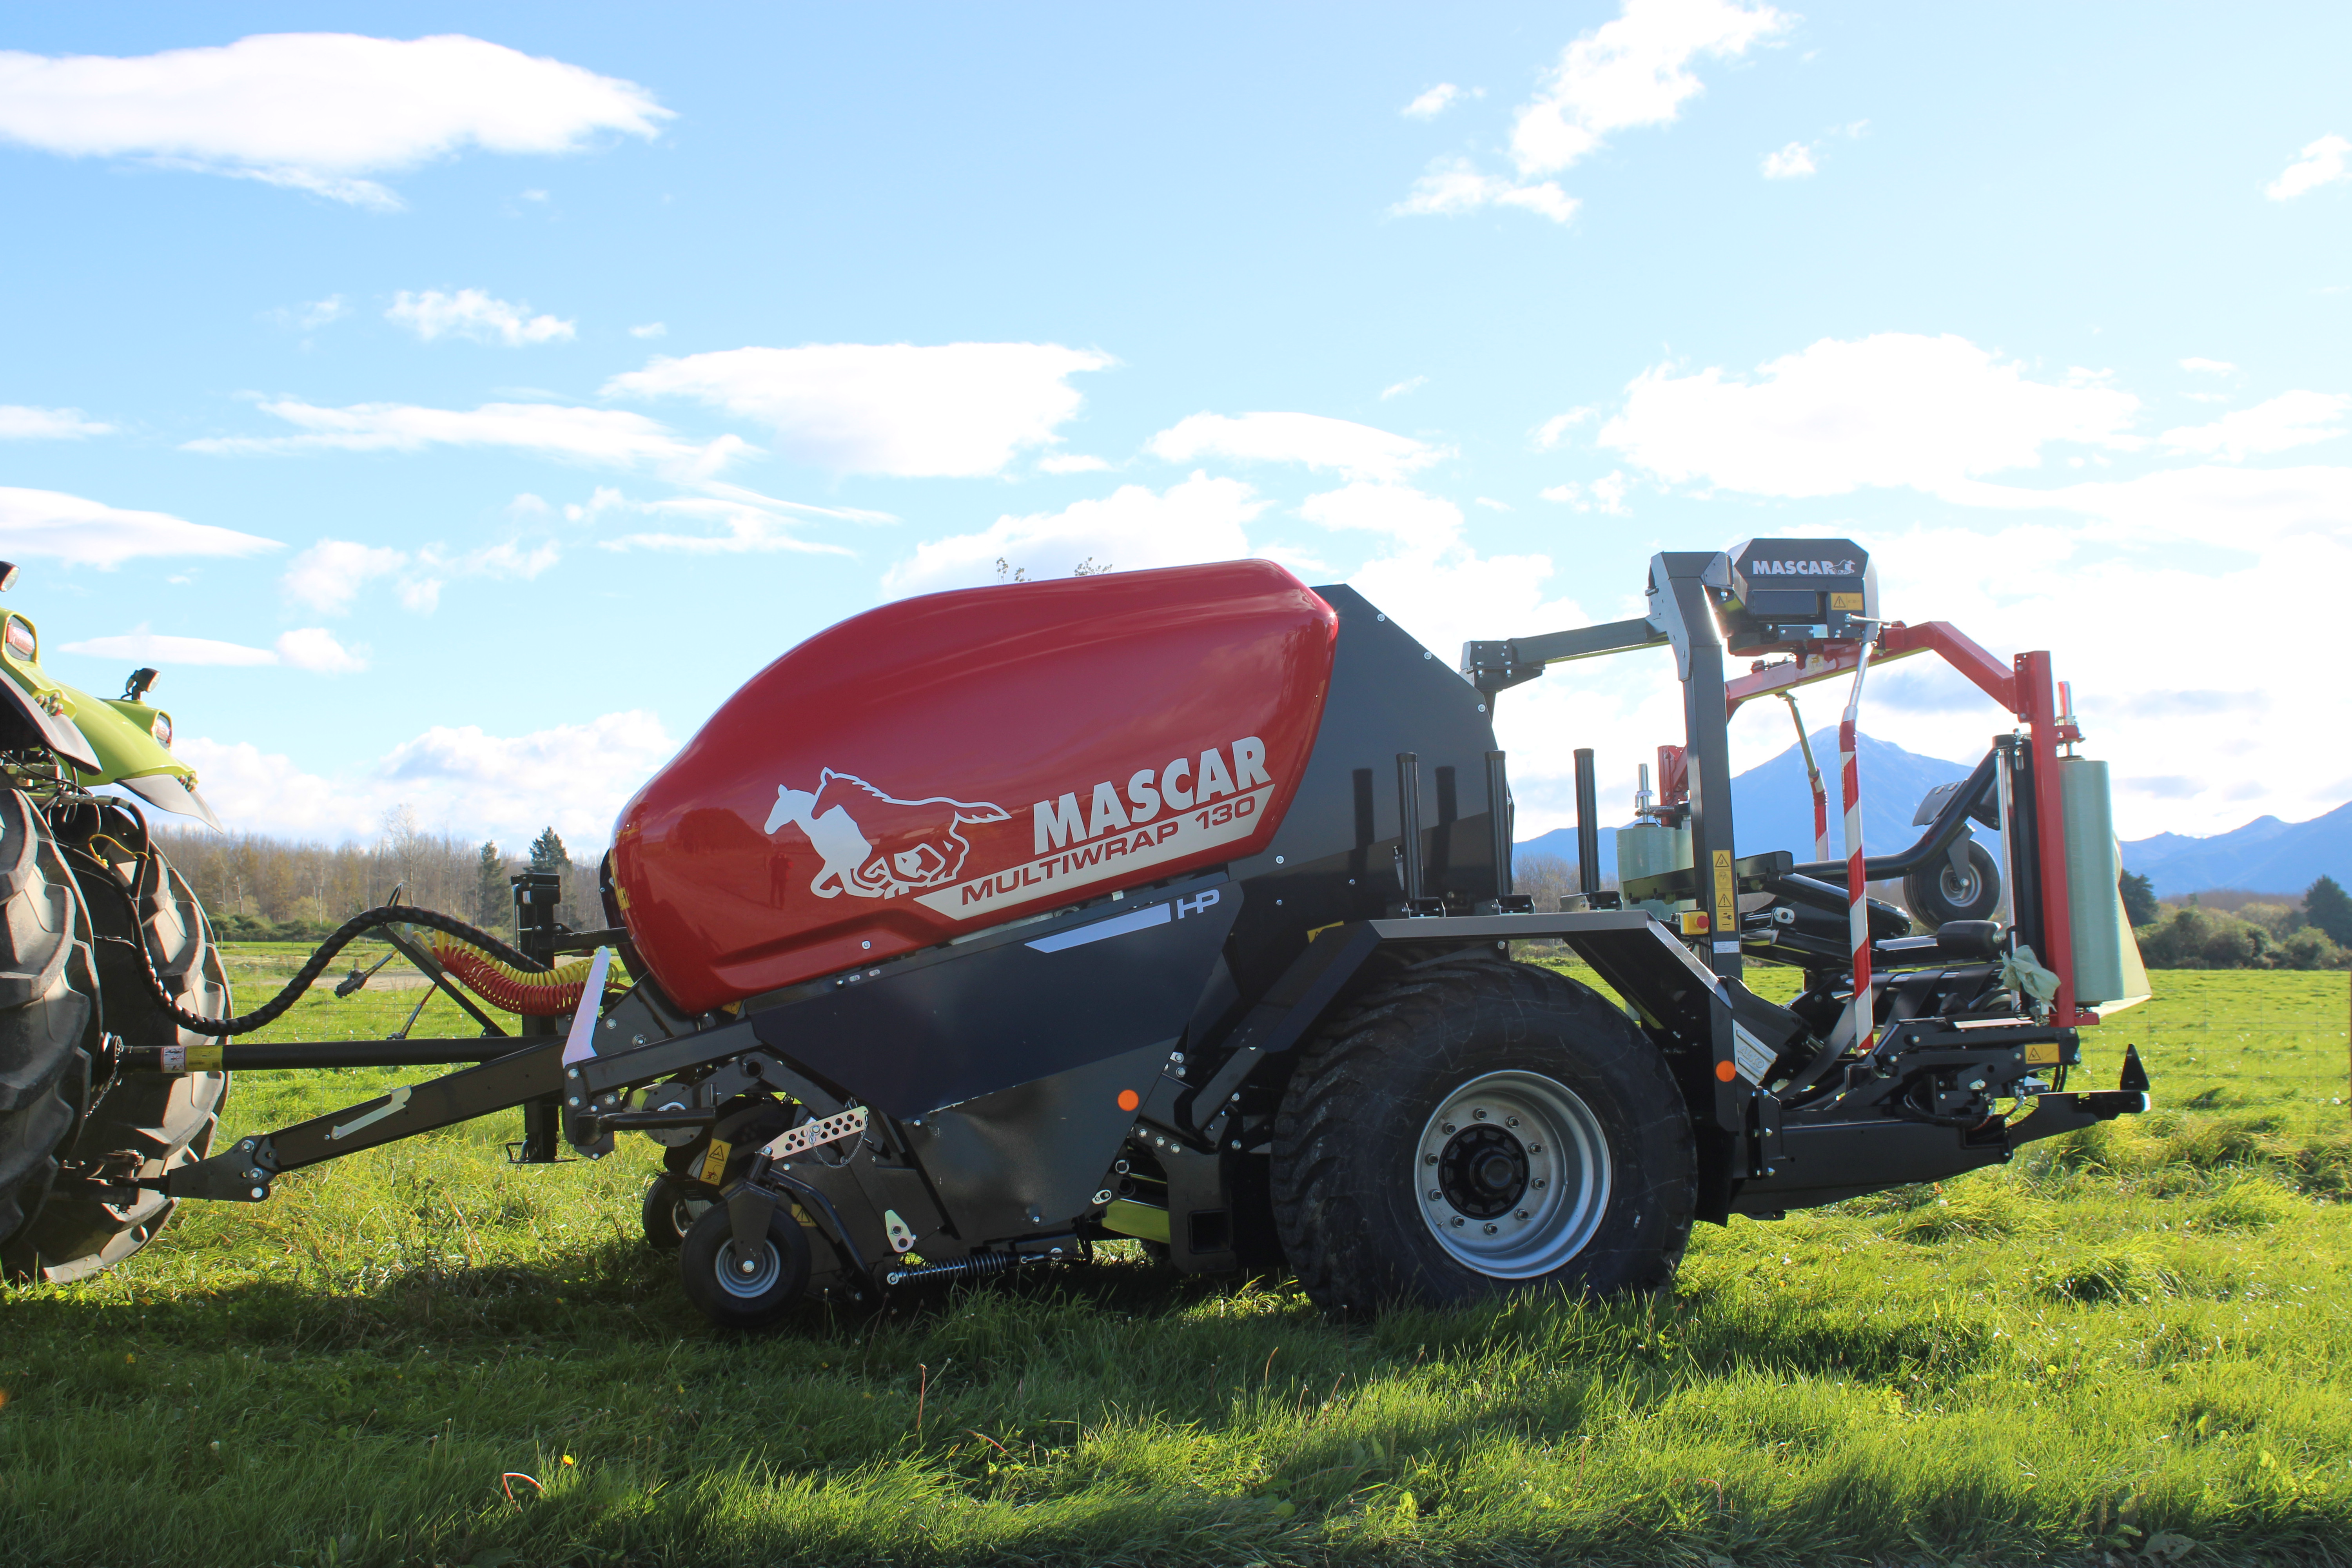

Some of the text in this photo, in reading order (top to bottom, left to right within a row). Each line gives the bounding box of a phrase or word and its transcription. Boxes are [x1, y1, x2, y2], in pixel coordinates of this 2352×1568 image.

[1753, 561, 1836, 575] MASCAR
[1033, 736, 1271, 856] MASCAR
[962, 795, 1256, 906] MULTIWRAP 130
[1177, 889, 1220, 919] HP
